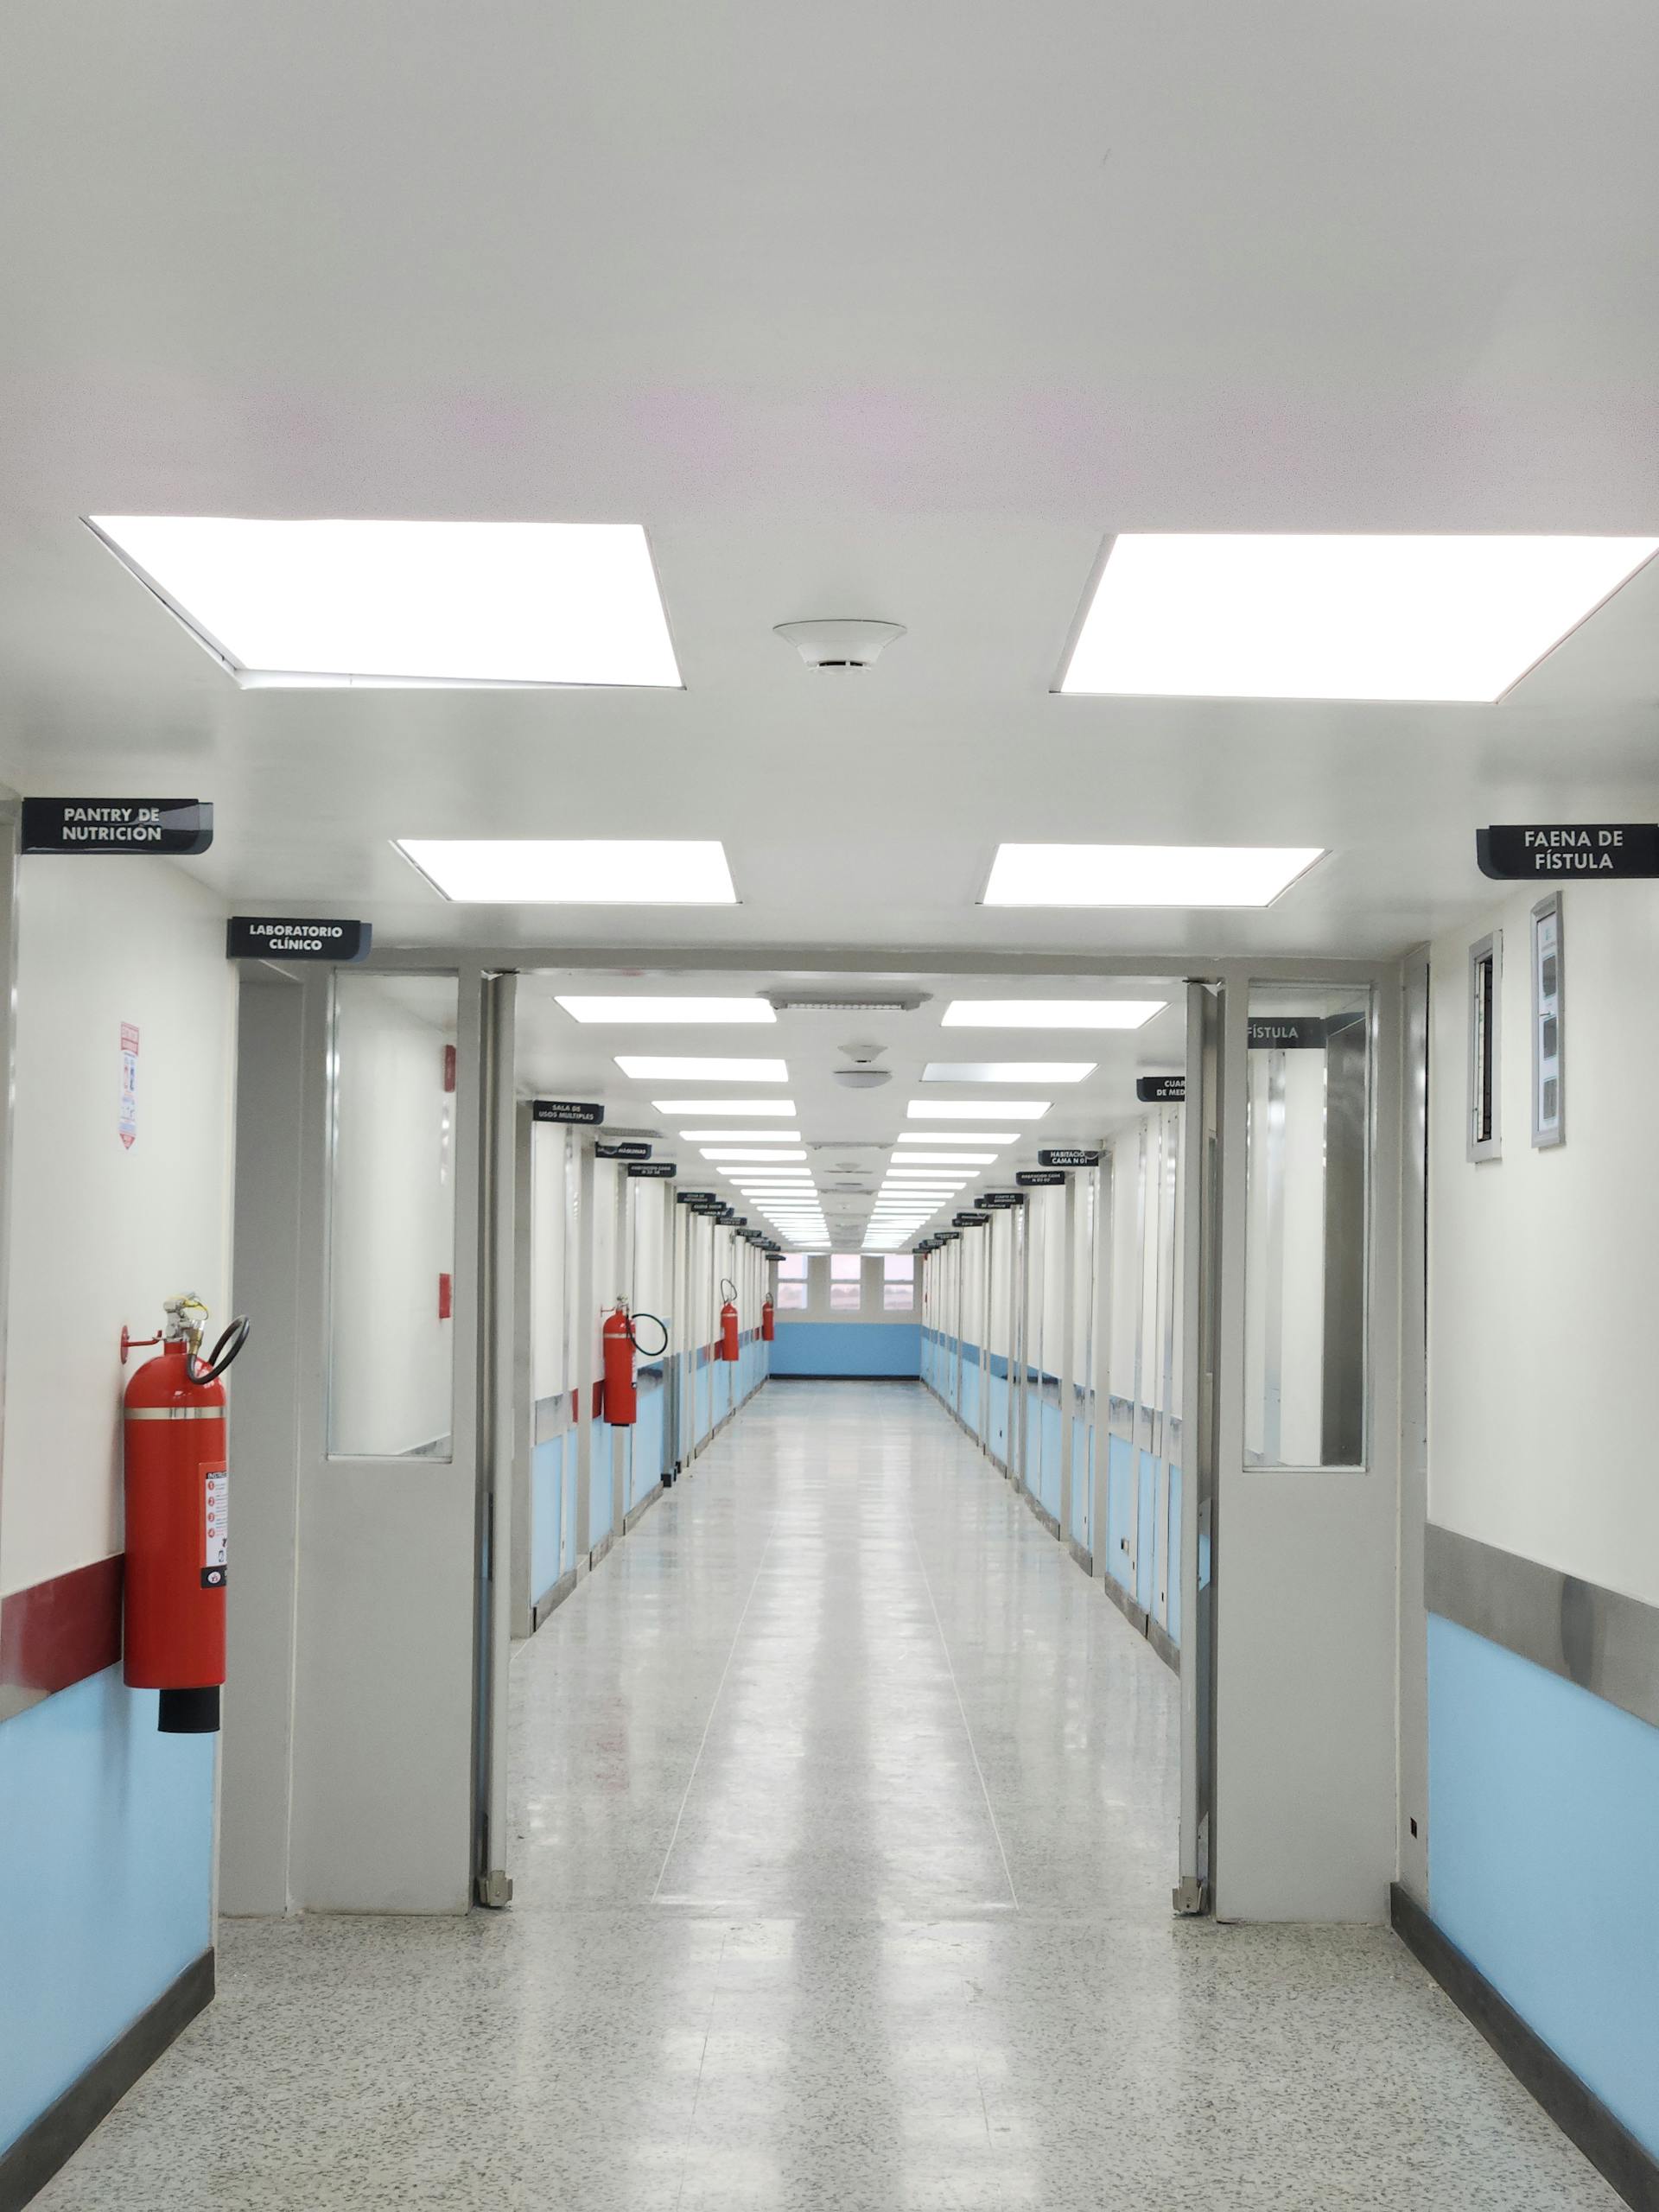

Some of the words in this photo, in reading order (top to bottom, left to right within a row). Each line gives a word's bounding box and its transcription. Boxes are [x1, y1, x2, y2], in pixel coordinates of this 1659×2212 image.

[64, 808, 132, 822] PANTRY
[138, 808, 160, 822] DE
[62, 823, 162, 841] NUTRICIÓN
[1524, 830, 1592, 847] FAENA
[1599, 830, 1624, 847] DE
[1535, 849, 1614, 869] FÍSTULA
[250, 925, 343, 938] LABORATORIO
[269, 937, 322, 950] CLÍNICO
